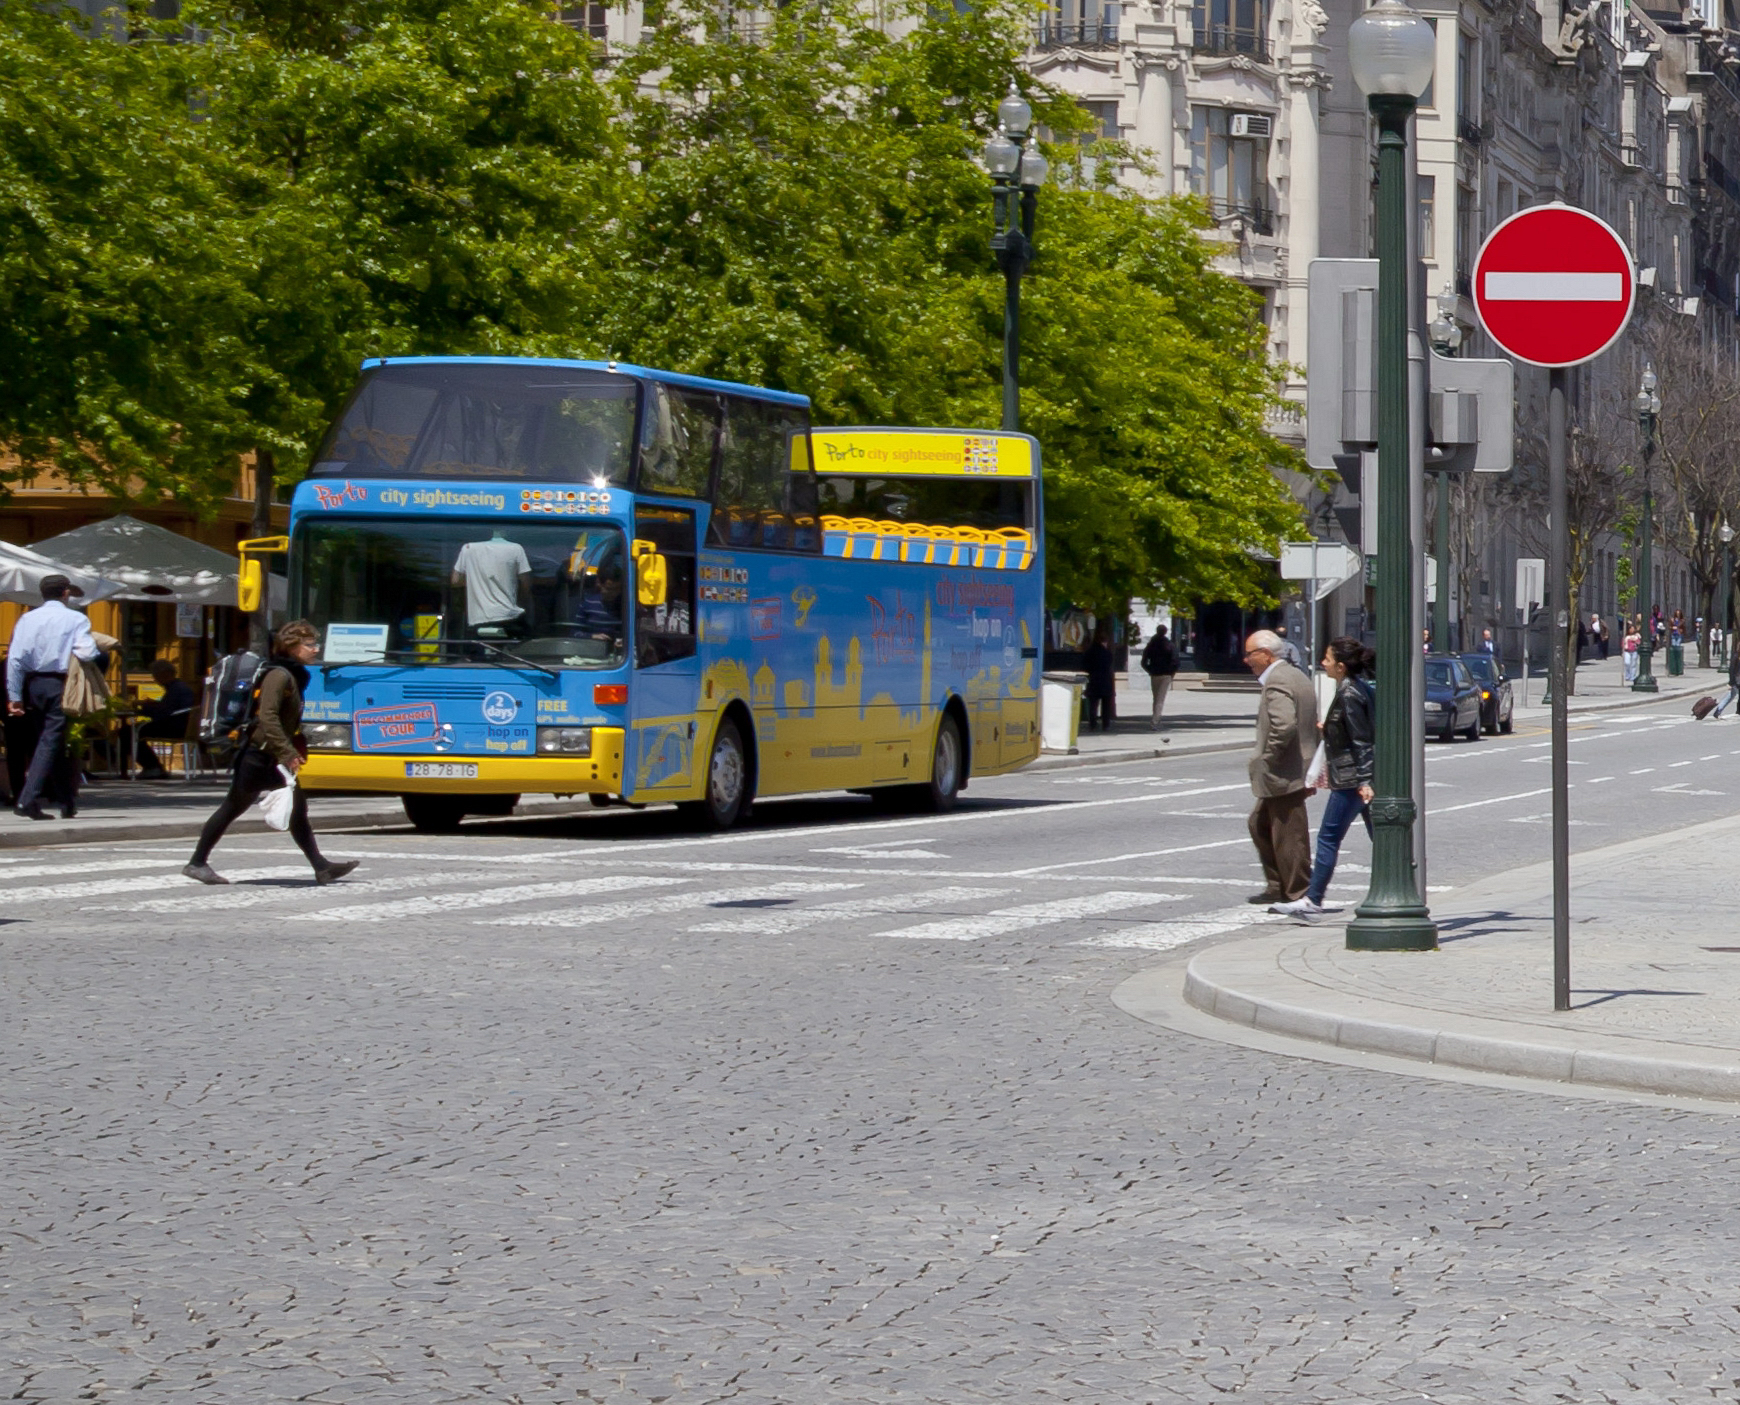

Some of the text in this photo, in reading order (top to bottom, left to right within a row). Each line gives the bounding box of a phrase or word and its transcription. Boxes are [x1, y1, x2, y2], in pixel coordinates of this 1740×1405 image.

[823, 442, 962, 464] Porto city sightseeing
[313, 480, 505, 509] Porto city sightseeing
[972, 611, 1002, 644] hop on
[495, 695, 505, 707] 2
[537, 699, 568, 712] FREE
[486, 705, 514, 720] days
[379, 723, 416, 738] TOUR
[487, 725, 529, 739] hop on
